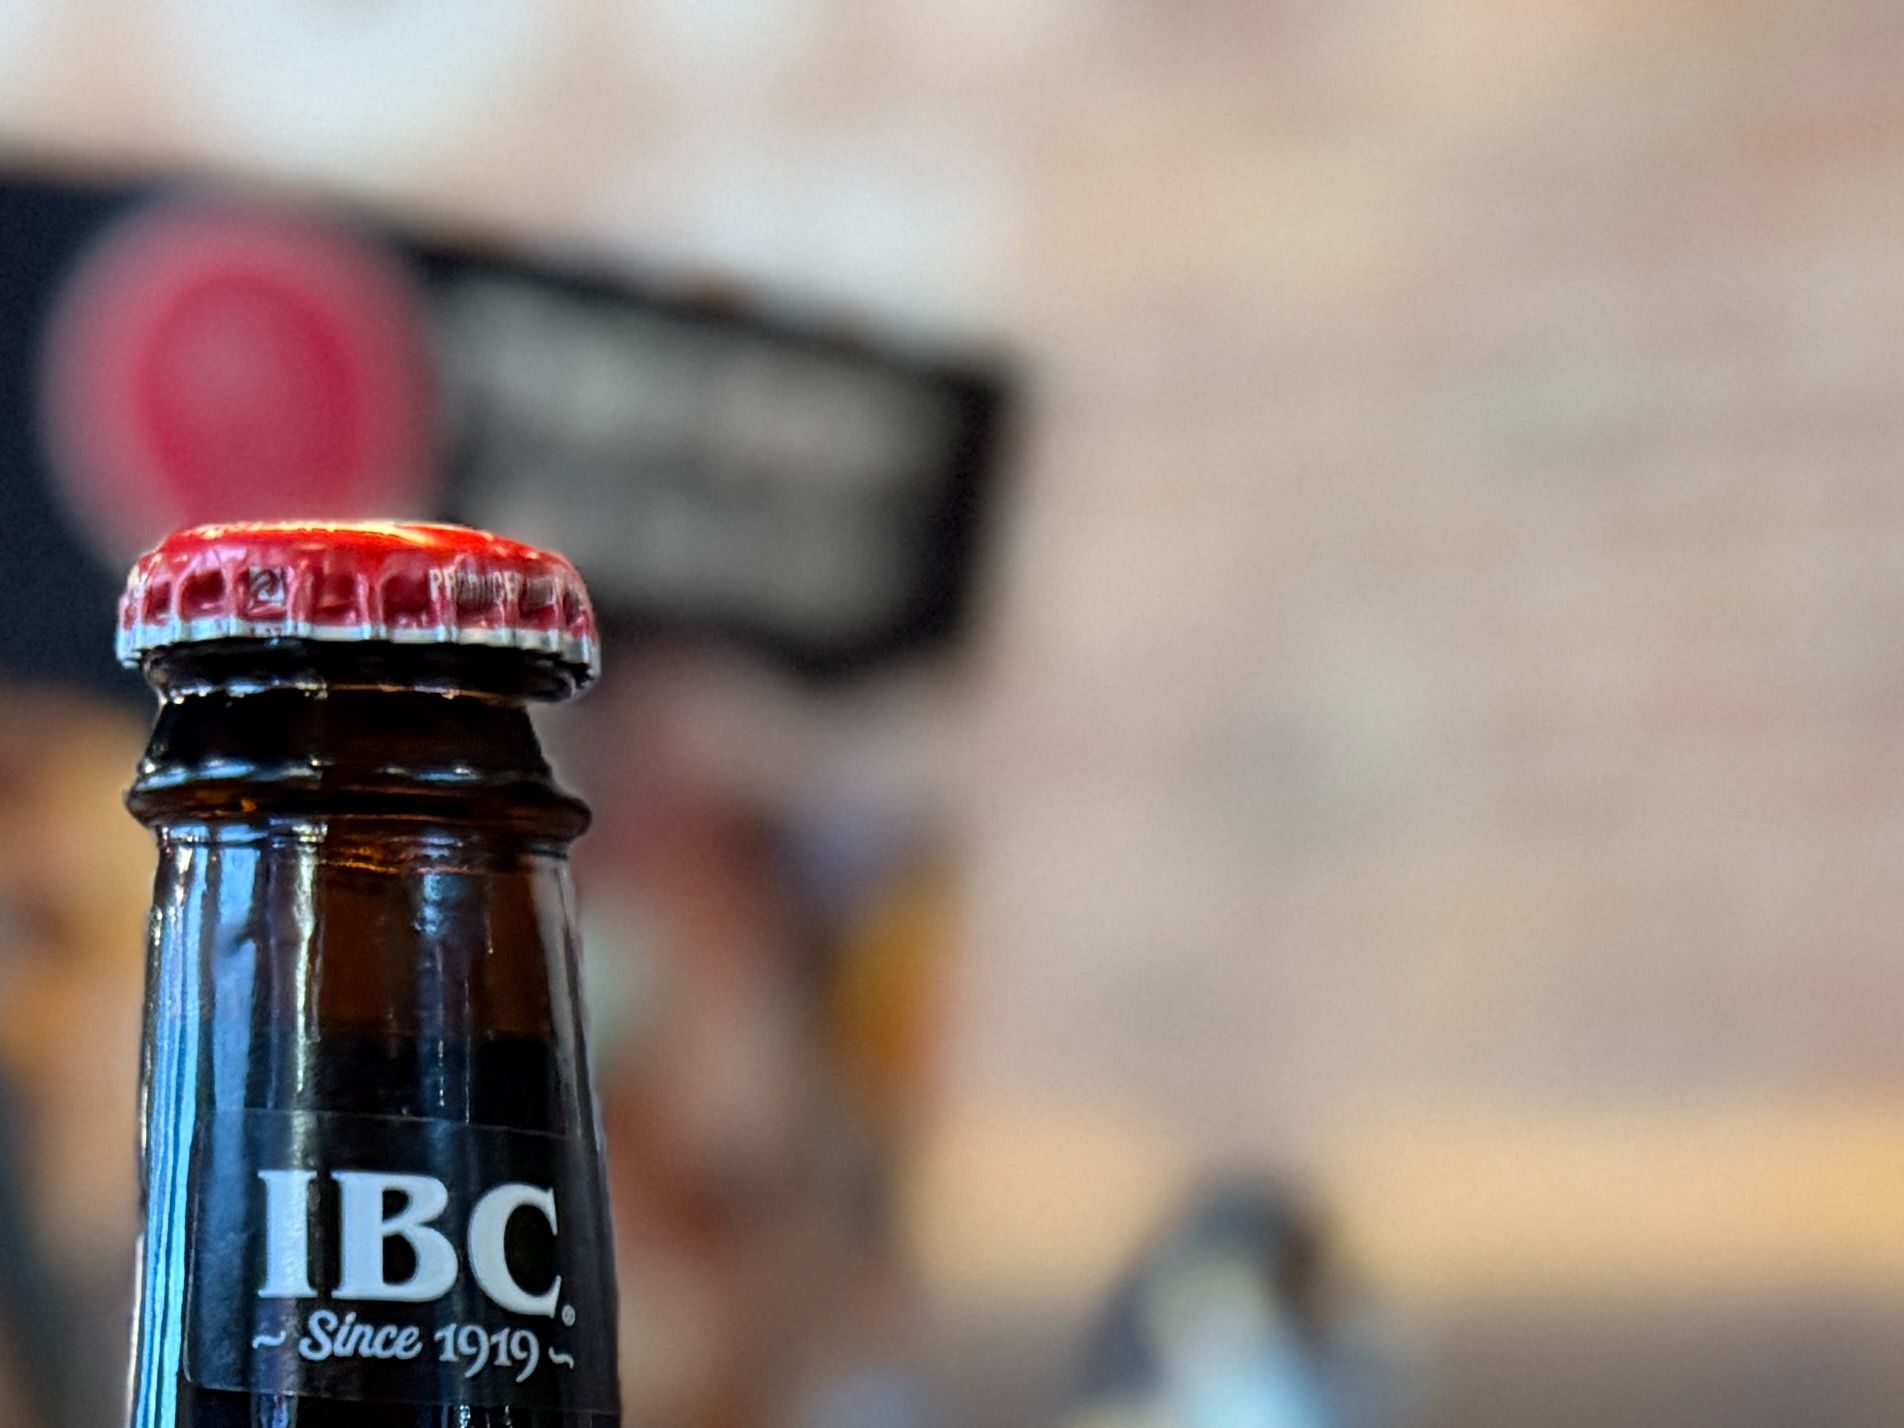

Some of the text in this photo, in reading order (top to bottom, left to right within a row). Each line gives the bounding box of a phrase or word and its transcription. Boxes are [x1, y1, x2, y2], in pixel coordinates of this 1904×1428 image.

[257, 1168, 562, 1319] IBC
[298, 1310, 541, 1384] Since 1919
